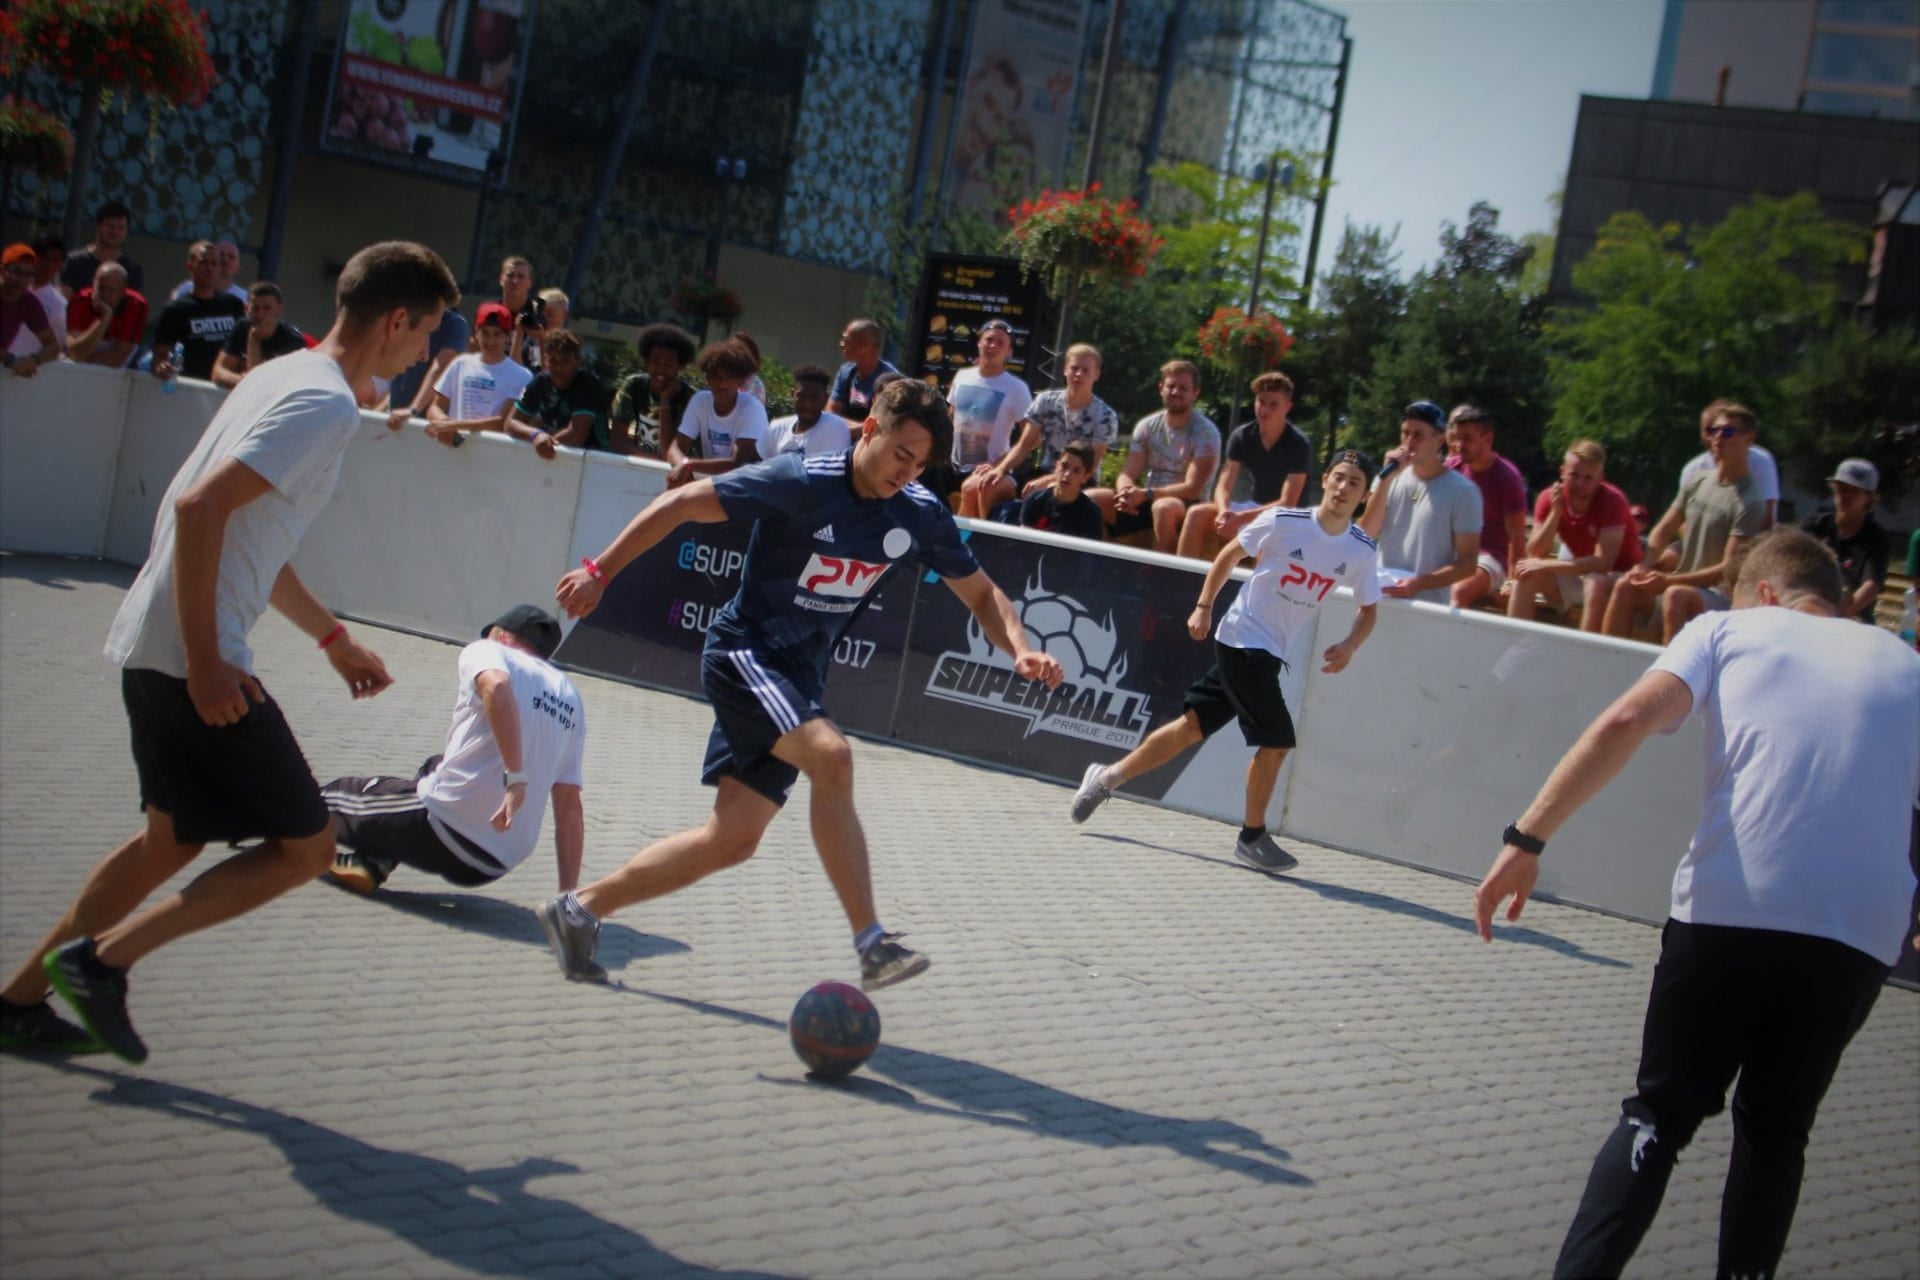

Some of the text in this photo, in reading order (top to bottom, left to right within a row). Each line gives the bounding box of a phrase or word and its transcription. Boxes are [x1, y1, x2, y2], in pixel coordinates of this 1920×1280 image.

[532, 696, 557, 718] give
[543, 690, 575, 717] never
[932, 655, 1143, 734] SUPERBALL
[1051, 718, 1137, 745] PRAGUE 2017
